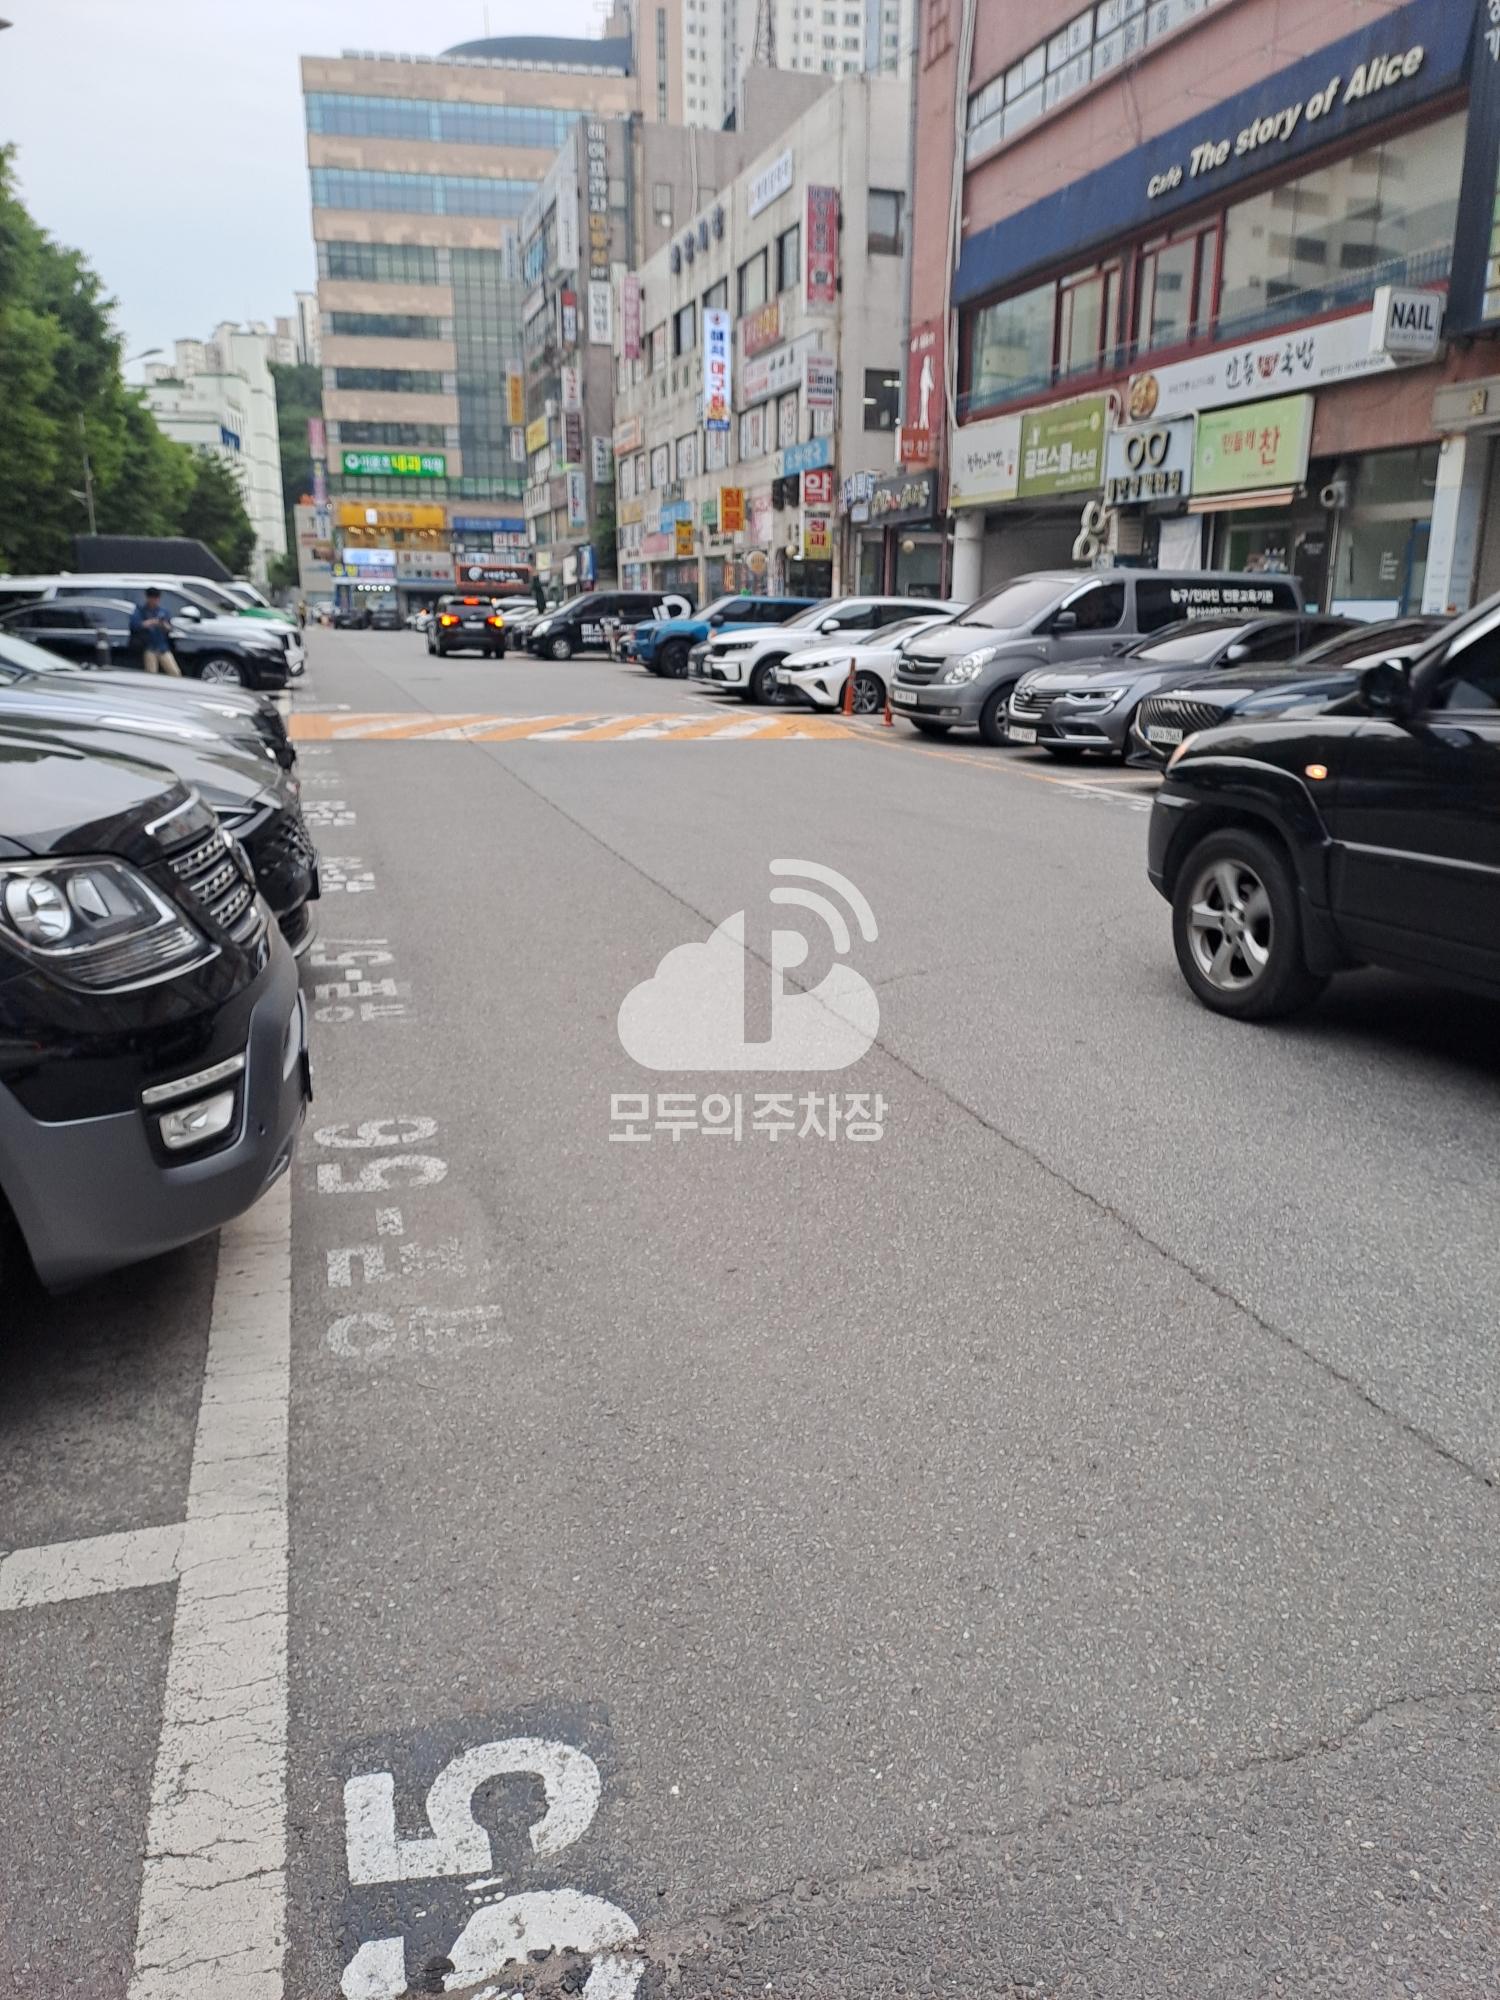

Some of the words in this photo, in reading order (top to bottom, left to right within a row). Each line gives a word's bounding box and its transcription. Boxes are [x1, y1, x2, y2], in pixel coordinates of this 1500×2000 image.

[1147, 165, 1184, 199] Cafe
[1189, 138, 1231, 178] The
[1235, 103, 1303, 156] story
[1305, 76, 1342, 122] of
[1343, 45, 1425, 105] Alice
[1390, 301, 1434, 332] NAIL
[804, 472, 832, 502] 약
